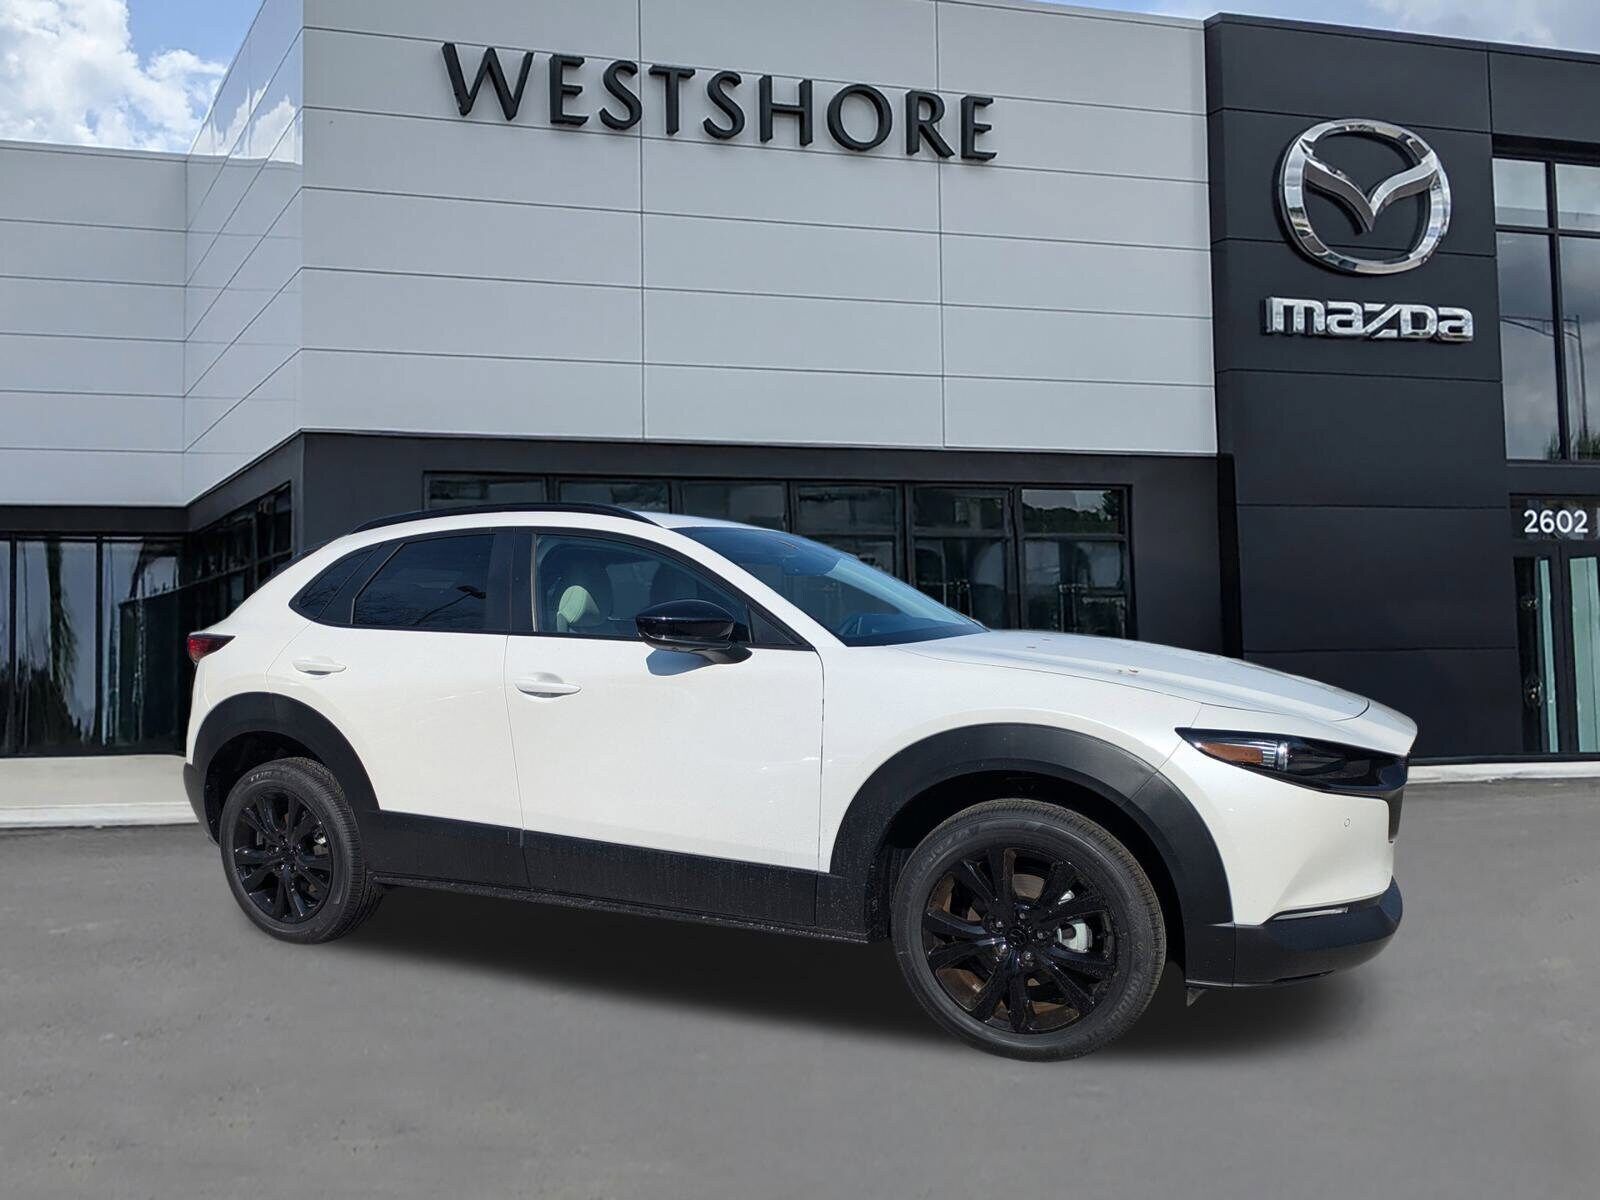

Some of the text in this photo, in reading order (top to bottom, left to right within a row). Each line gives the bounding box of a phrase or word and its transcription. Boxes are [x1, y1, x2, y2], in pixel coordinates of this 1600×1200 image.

[442, 42, 997, 161] WESTSHORE
[1265, 296, 1474, 342] mazda
[1523, 509, 1589, 534] 2602
